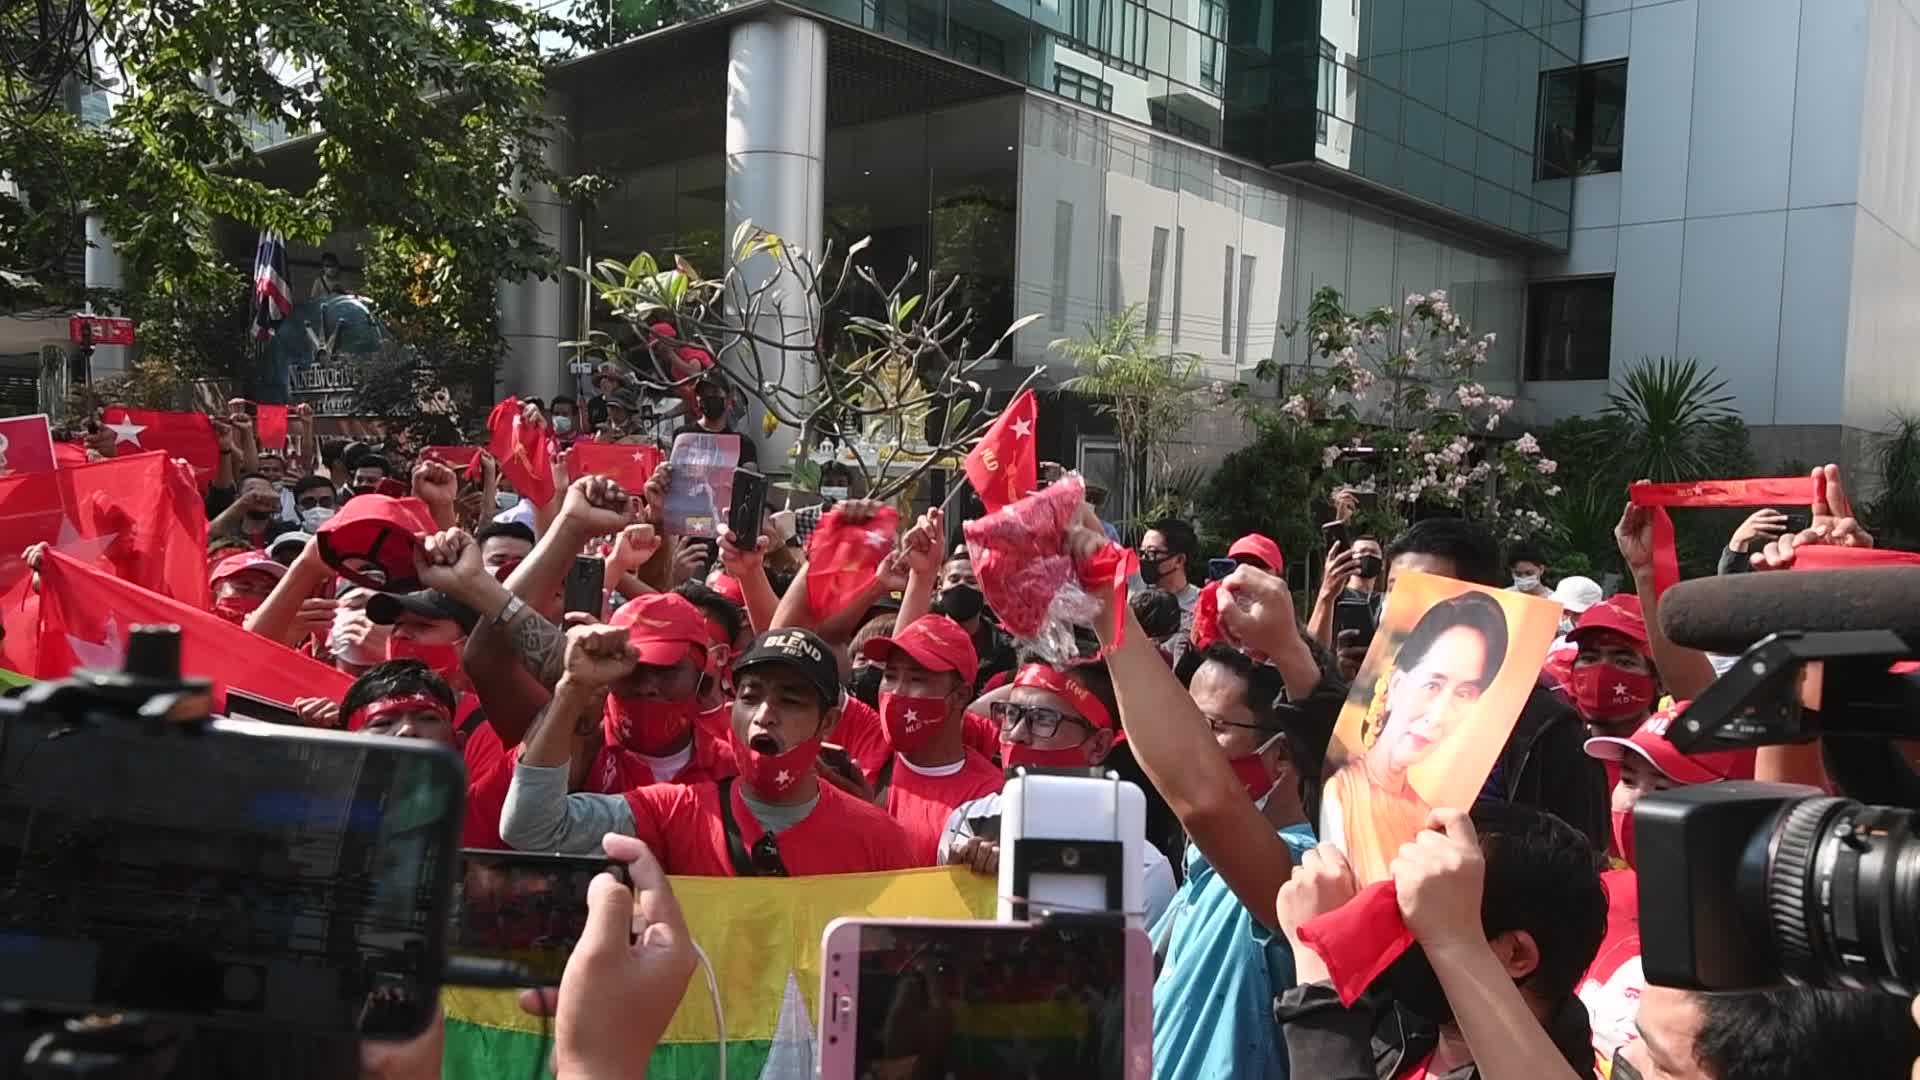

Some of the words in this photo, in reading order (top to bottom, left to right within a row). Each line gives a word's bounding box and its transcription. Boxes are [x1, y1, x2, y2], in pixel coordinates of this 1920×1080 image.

[980, 448, 999, 471] NLD
[763, 634, 822, 662] BLEND
[1644, 716, 1669, 736] NL
